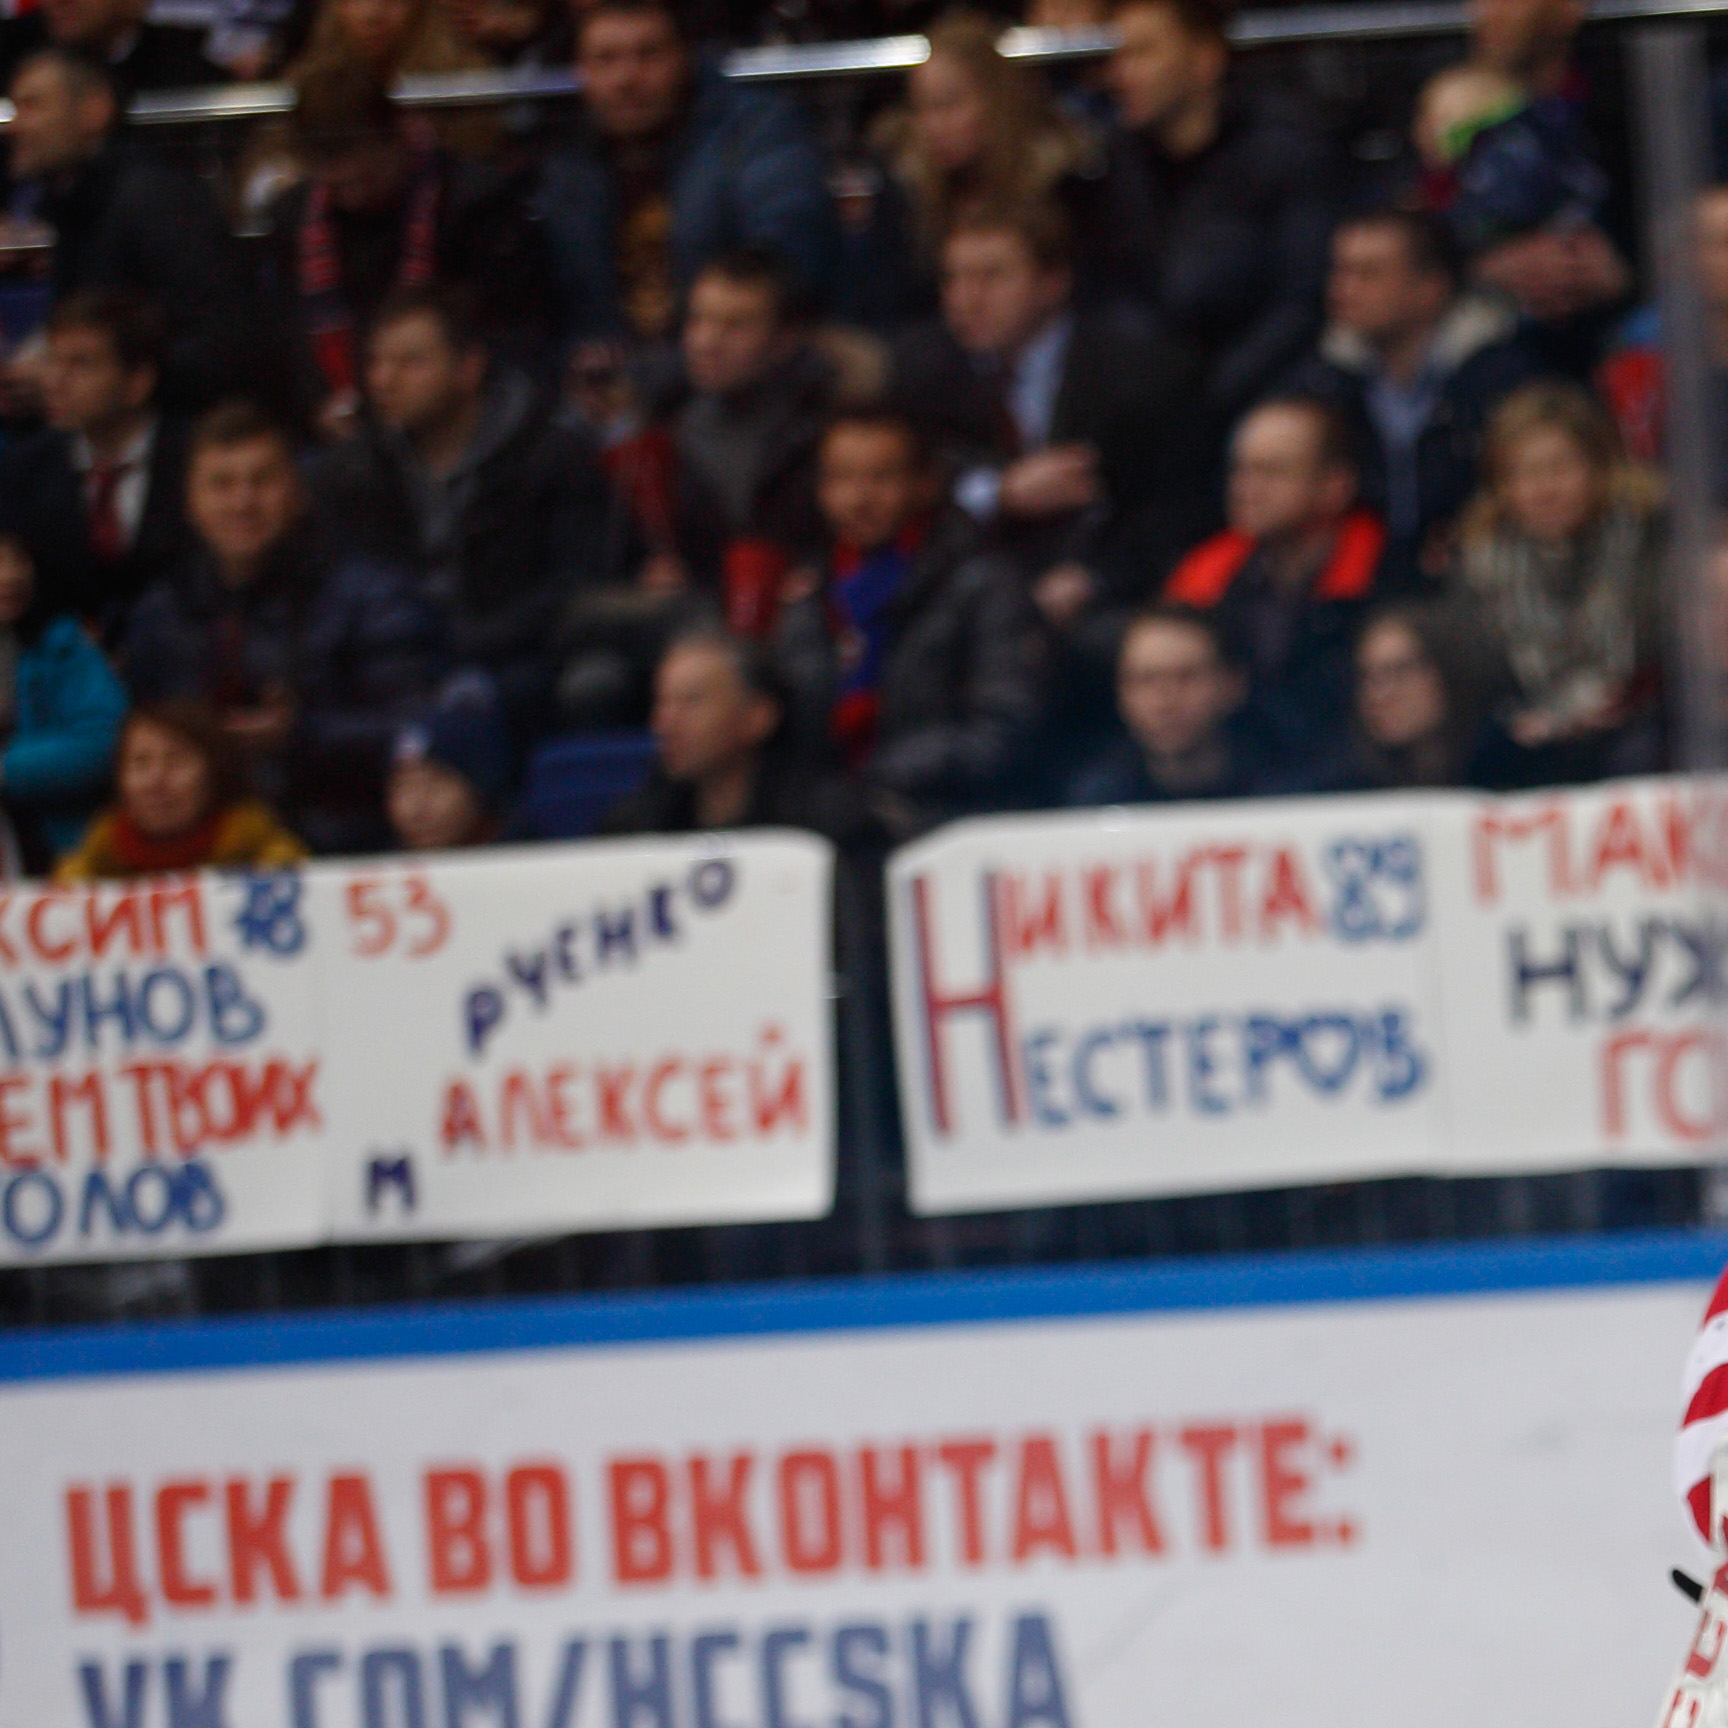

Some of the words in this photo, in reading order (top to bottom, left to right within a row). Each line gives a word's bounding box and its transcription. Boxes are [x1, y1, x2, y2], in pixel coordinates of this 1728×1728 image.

[342, 868, 453, 961] 53
[1324, 831, 1429, 945] 89
[437, 1023, 811, 1161] АЛЕКСЕЙ
[66, 1466, 391, 1629] ЦСКА
[424, 1458, 574, 1595] ВО
[606, 1408, 1358, 1590] ВКОНТАКТЕ:
